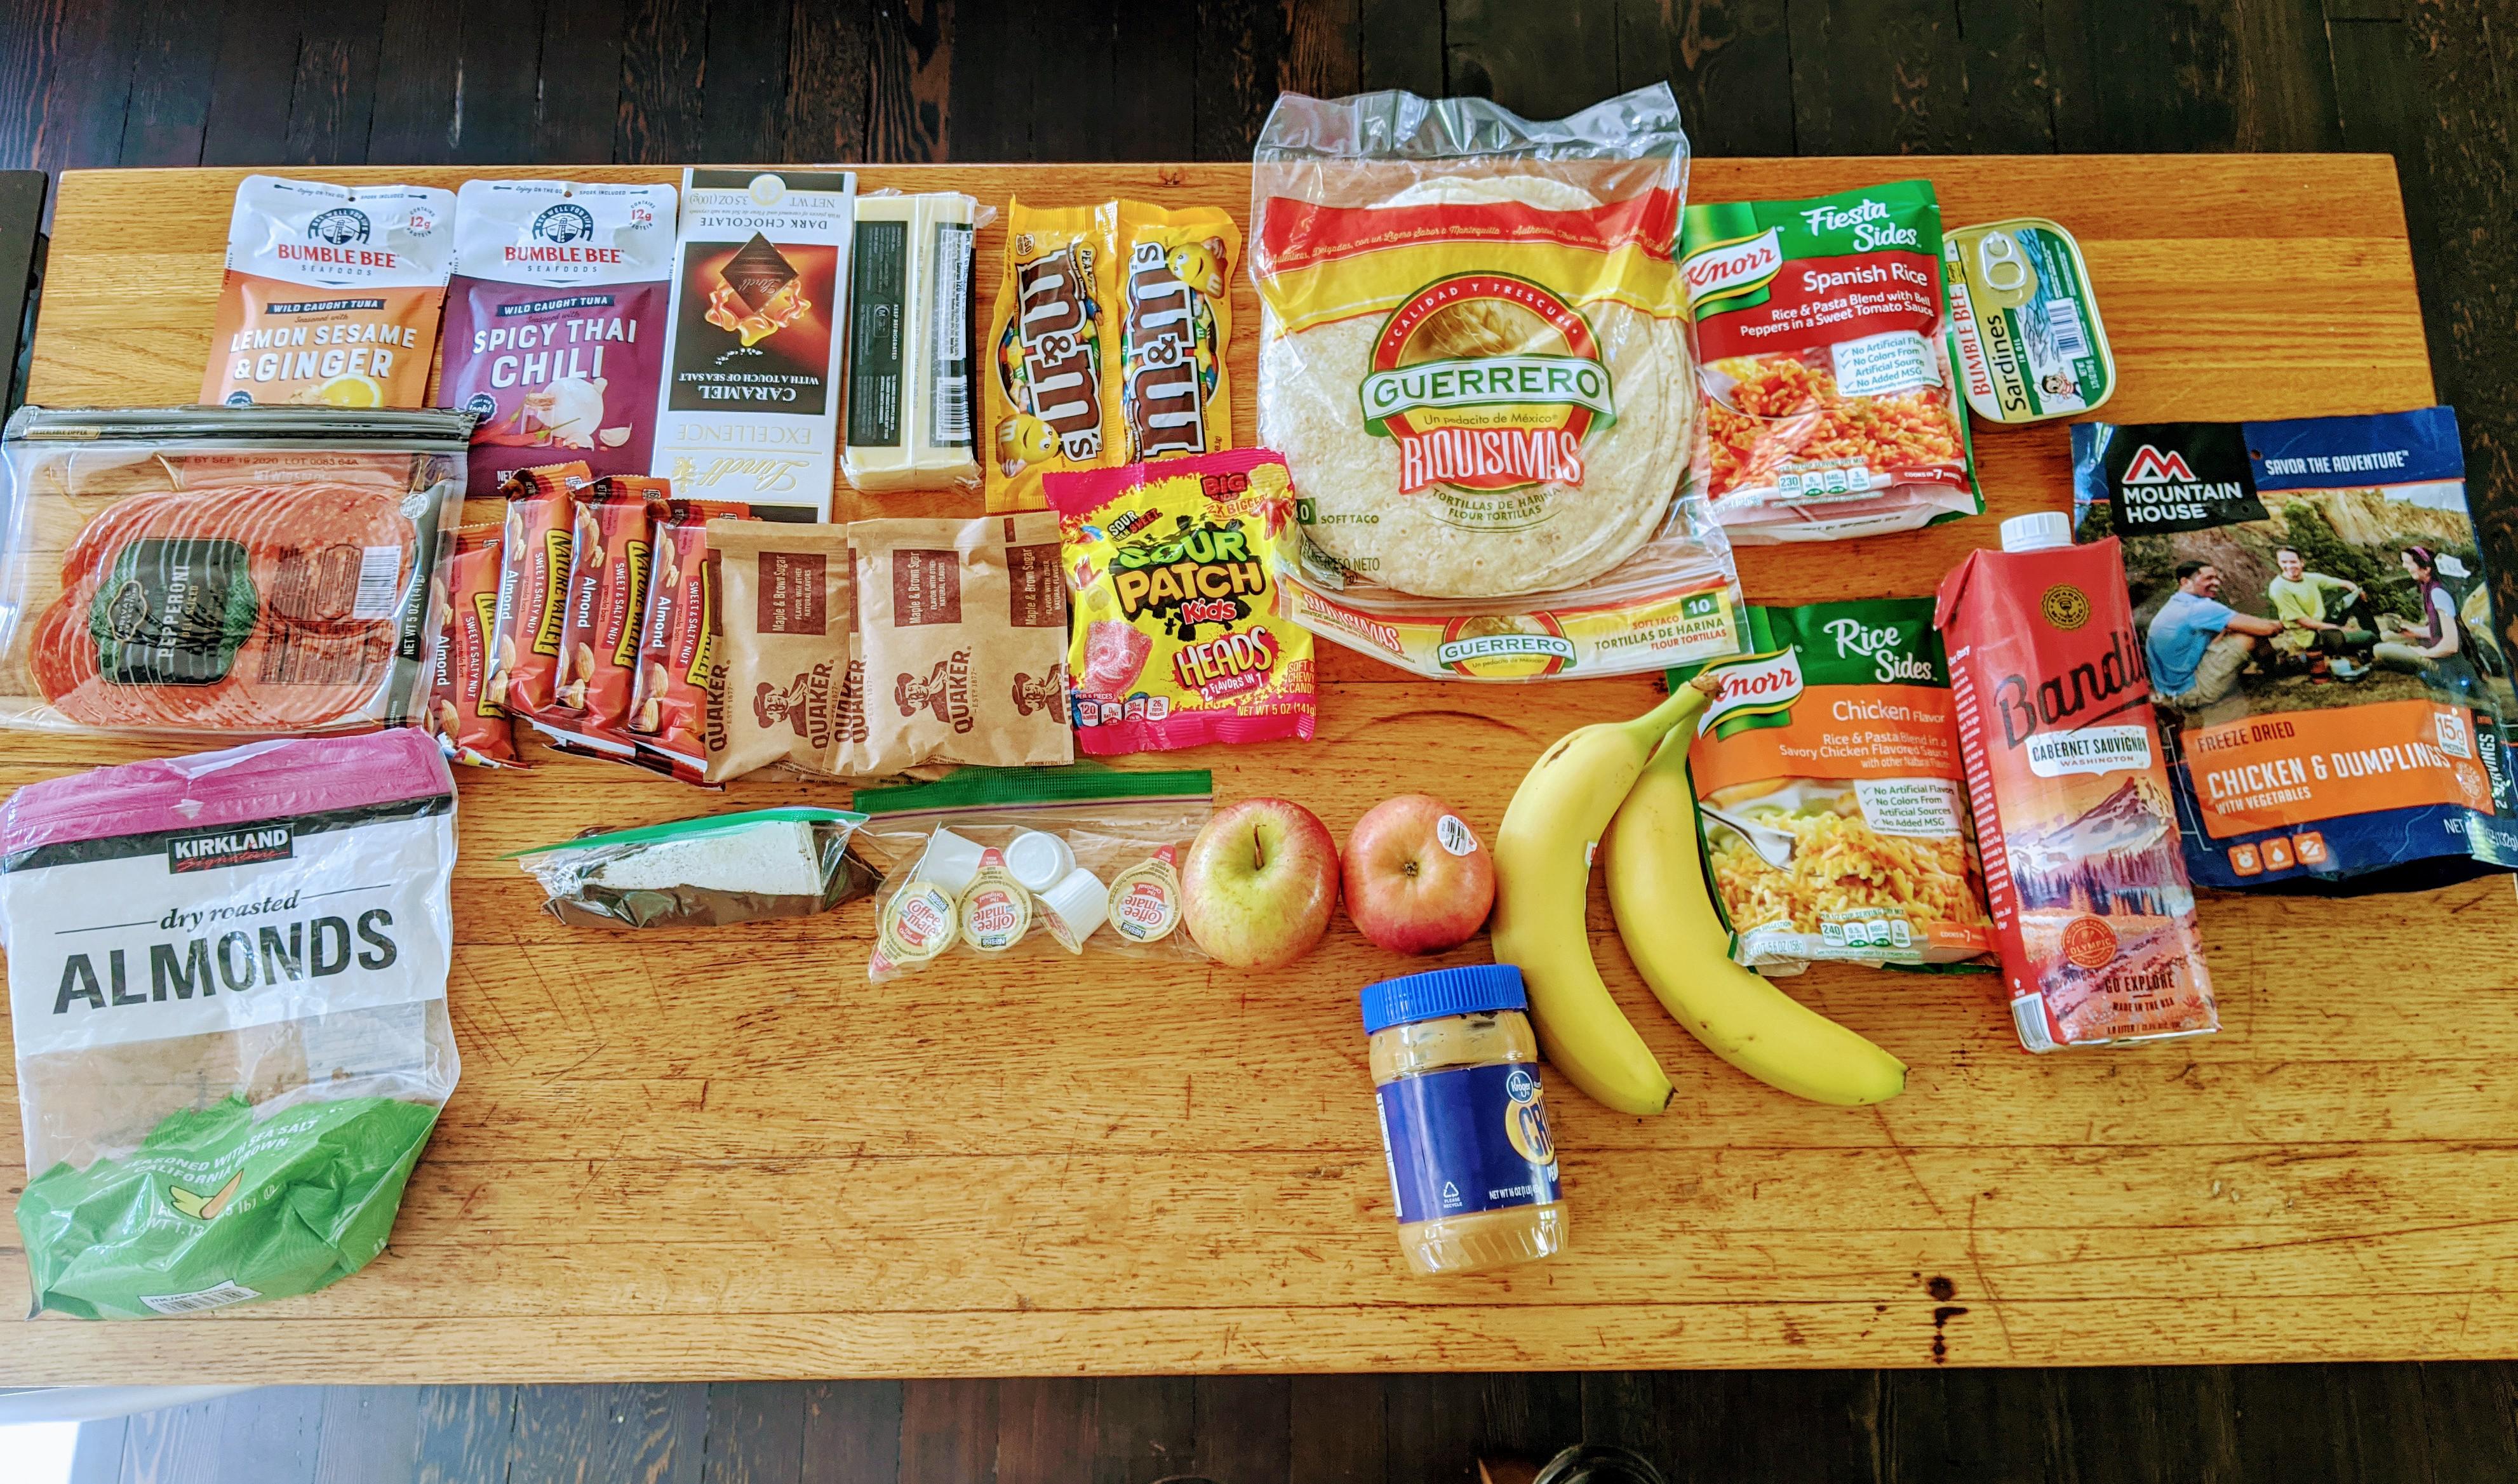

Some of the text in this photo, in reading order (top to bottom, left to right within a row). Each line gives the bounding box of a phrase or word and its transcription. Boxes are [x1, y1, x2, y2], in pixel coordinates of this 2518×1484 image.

[631, 209, 652, 221] 12g
[790, 197, 835, 208] NET WT
[410, 216, 431, 229] 12g
[700, 217, 827, 229] DARK CHOCOLATE
[1800, 199, 1890, 237] Fiesta
[1853, 224, 1917, 252] Sides
[278, 244, 398, 268] BUMBLE BEE
[504, 246, 622, 264] BUMBLE BEE
[1686, 246, 1776, 286] Knorr
[302, 265, 372, 276] SEAFOODS
[1803, 262, 1928, 293] Spanish Rice
[273, 300, 378, 313] WILD CAUGHT TUNA
[504, 297, 608, 315] WILD CAUGHT TUNA
[1393, 283, 1572, 338] CALIDAD Y FRESCURA
[1771, 290, 1931, 321] Rice & Pasta Blend with Bell
[1741, 301, 1935, 338] Peppers in Sweet Tomato Sauce
[231, 324, 418, 352] LEMON SESAME
[473, 318, 637, 354] SPICY THAI
[234, 349, 394, 382] & GINGER
[491, 346, 605, 389] CHILI
[1958, 325, 1992, 396] BUMBLE
[1988, 315, 2026, 411] Sardines
[679, 372, 819, 385] WITH TOUCH OF SEA SALT
[1374, 366, 1600, 406] GUERRERO
[1871, 366, 1922, 384] Added MSG
[699, 385, 796, 401] CARAMEL
[1424, 415, 1440, 425] Un
[1444, 413, 1490, 425] pedacito
[1493, 413, 1506, 424] de
[677, 424, 811, 444] EXCELLENCE
[1402, 428, 1581, 490] RIQUISIMAS
[2265, 452, 2405, 476] SAVOR THE ADVENTURE
[697, 457, 810, 491] Lindt
[1202, 474, 1247, 494] BIG
[1781, 478, 1798, 487] 230
[1432, 486, 1562, 511] TORTILLAS DE HARINA
[2122, 481, 2242, 505] MOUNTAIN
[1321, 514, 1379, 525] SOFT TACO
[1448, 506, 1542, 520] FLOUR TORTILLAS
[2126, 503, 2207, 524] HOUSE
[1118, 531, 1246, 568] SOUR
[535, 552, 544, 580] SWEET
[1353, 558, 1381, 572] NETO
[501, 570, 519, 620] Almond
[540, 535, 573, 652] NATURE VALLEY
[772, 554, 787, 631] Maple Brown Sugar
[1116, 563, 1262, 613] PATCH
[159, 566, 190, 657] PEPPERONI
[577, 577, 597, 628] Almond
[1181, 598, 1236, 625] Kids
[1689, 598, 1711, 614] 10
[652, 596, 672, 648] Almond
[1595, 618, 1725, 651] TORTILLAS DE HARINA
[1633, 615, 1680, 631] SOFT TACO
[403, 624, 416, 655] NET WT
[1445, 638, 1567, 658] GUERRERO
[1651, 629, 1727, 651] FLOUR TORTILLAS
[1823, 619, 1901, 658] Rice
[437, 635, 450, 686] Almond
[1176, 627, 1272, 686] HEADS
[1289, 660, 1308, 672] SOFT
[1875, 649, 1932, 683] Sides
[1210, 677, 1243, 694] FLAVORS
[1288, 672, 1315, 683] CHEWY
[1290, 683, 1315, 694] CANDY
[954, 648, 970, 734] QUAKER
[709, 664, 730, 752] QUAKER
[1238, 704, 1291, 716] NET WT OZ
[1833, 700, 1945, 724] Chicken Flavor
[2197, 721, 2295, 752] FREEZE DRIED
[2438, 717, 2465, 746] 15g
[1779, 745, 1919, 760] Savory Chicken Flavored
[2032, 736, 2147, 762] CABERNET SAUVIGNON
[2060, 755, 2134, 767] WASHINGTON
[2207, 742, 2451, 799] CHICKEN & DUMPLINGS
[1878, 806, 1952, 817] Artificial Sources
[2215, 786, 2312, 815] WITH VEGETABLES
[174, 830, 288, 860] KIRKLAND
[176, 848, 290, 872] Signature
[160, 891, 300, 933] dry roasted
[974, 906, 1005, 921] mate
[1823, 924, 1841, 935] 240
[2070, 938, 2111, 954] OLYMPIC
[53, 909, 398, 1014] ALMONDS
[2105, 972, 2174, 993] GO EXPLORE
[1511, 1076, 1530, 1098] Kroger
[214, 1120, 318, 1168] WITH SEA SALT
[234, 1137, 290, 1168] GROWN
